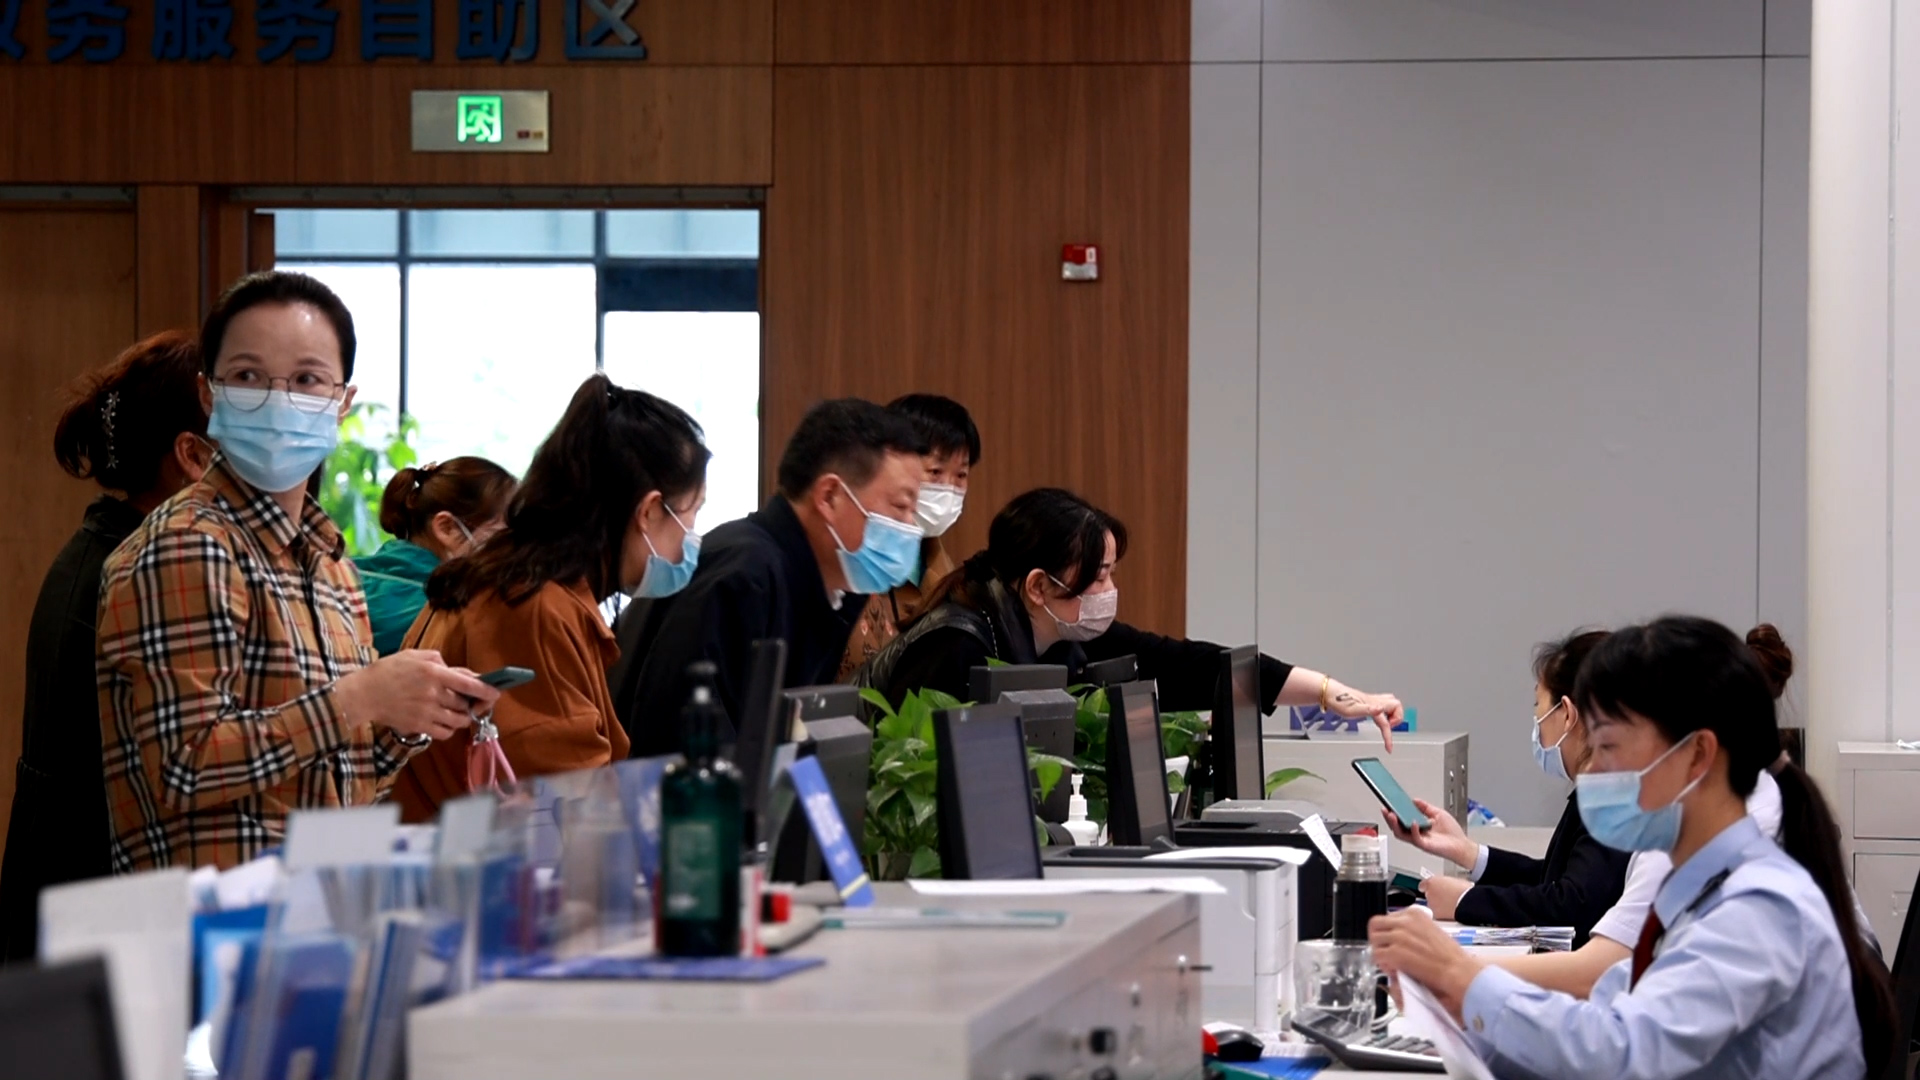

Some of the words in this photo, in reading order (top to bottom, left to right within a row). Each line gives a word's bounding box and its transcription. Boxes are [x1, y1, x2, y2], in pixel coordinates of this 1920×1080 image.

[0, 0, 647, 62] 务服务自助区
